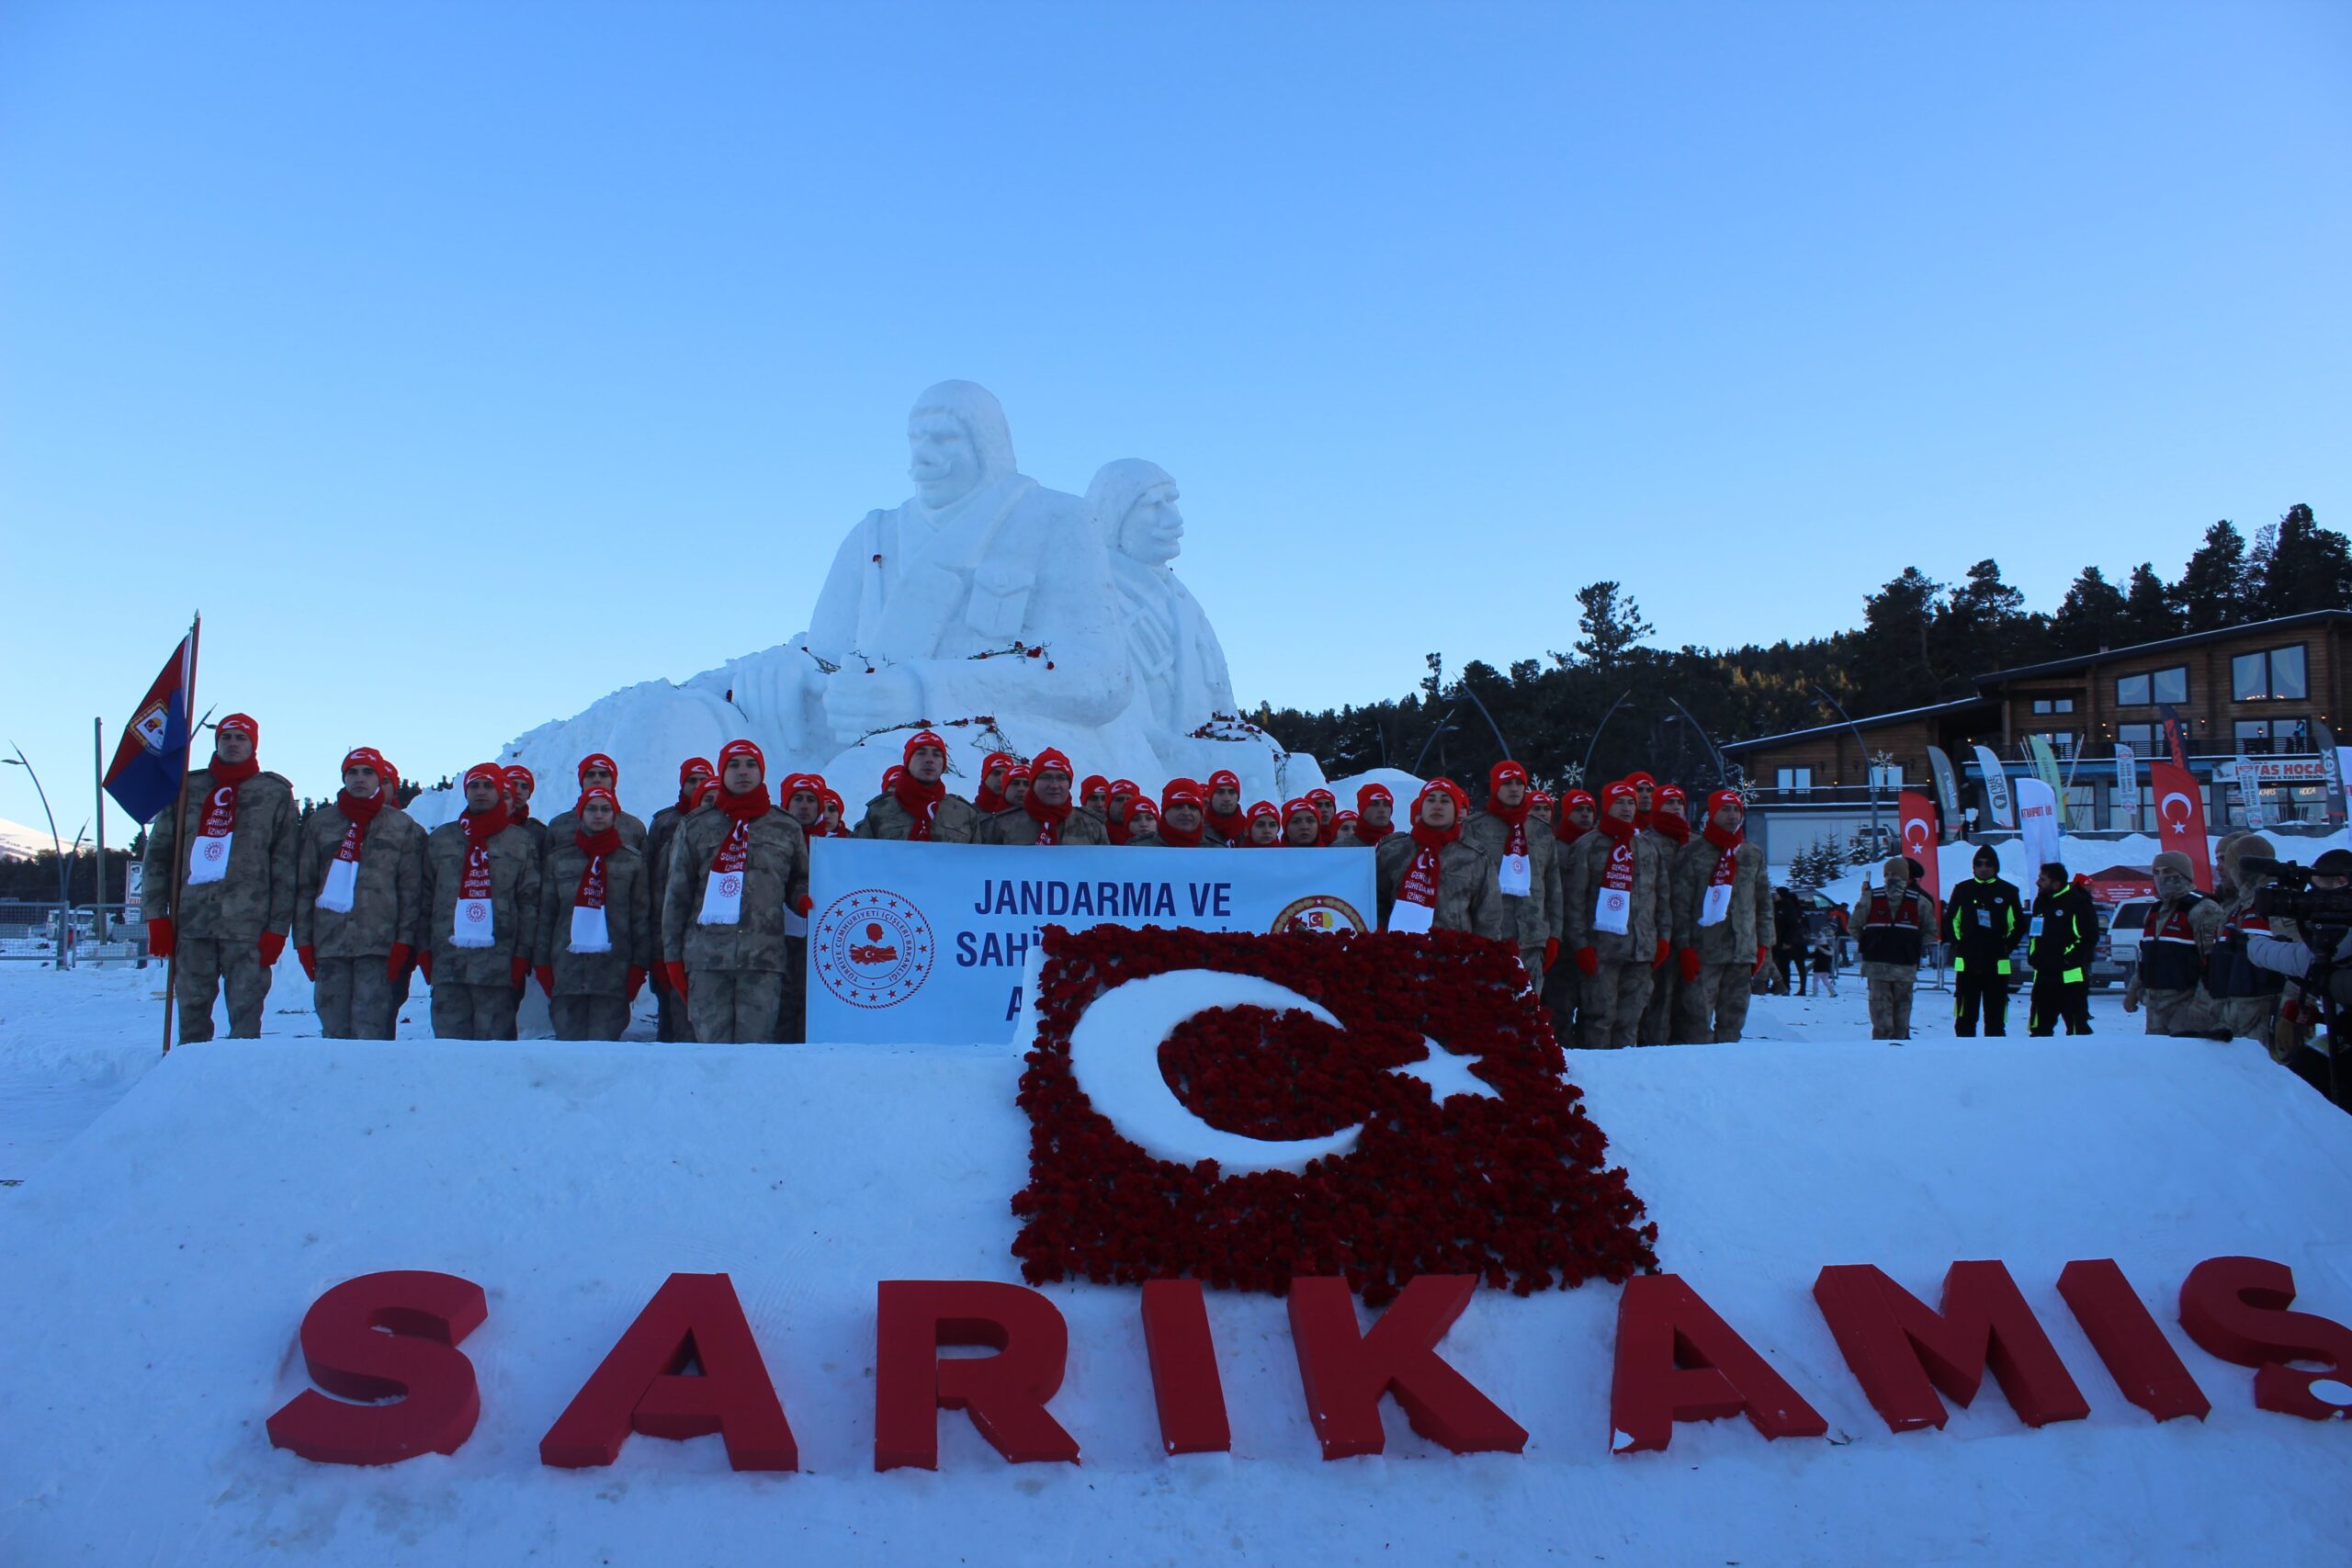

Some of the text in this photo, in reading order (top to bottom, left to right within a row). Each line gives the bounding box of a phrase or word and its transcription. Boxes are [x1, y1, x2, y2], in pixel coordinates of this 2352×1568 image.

[2284, 763, 2323, 774] HOCA
[975, 880, 1231, 917] JANDARMA VE
[835, 910, 879, 948] CUMHURİYETİ
[835, 950, 858, 983] TÜRKİYE
